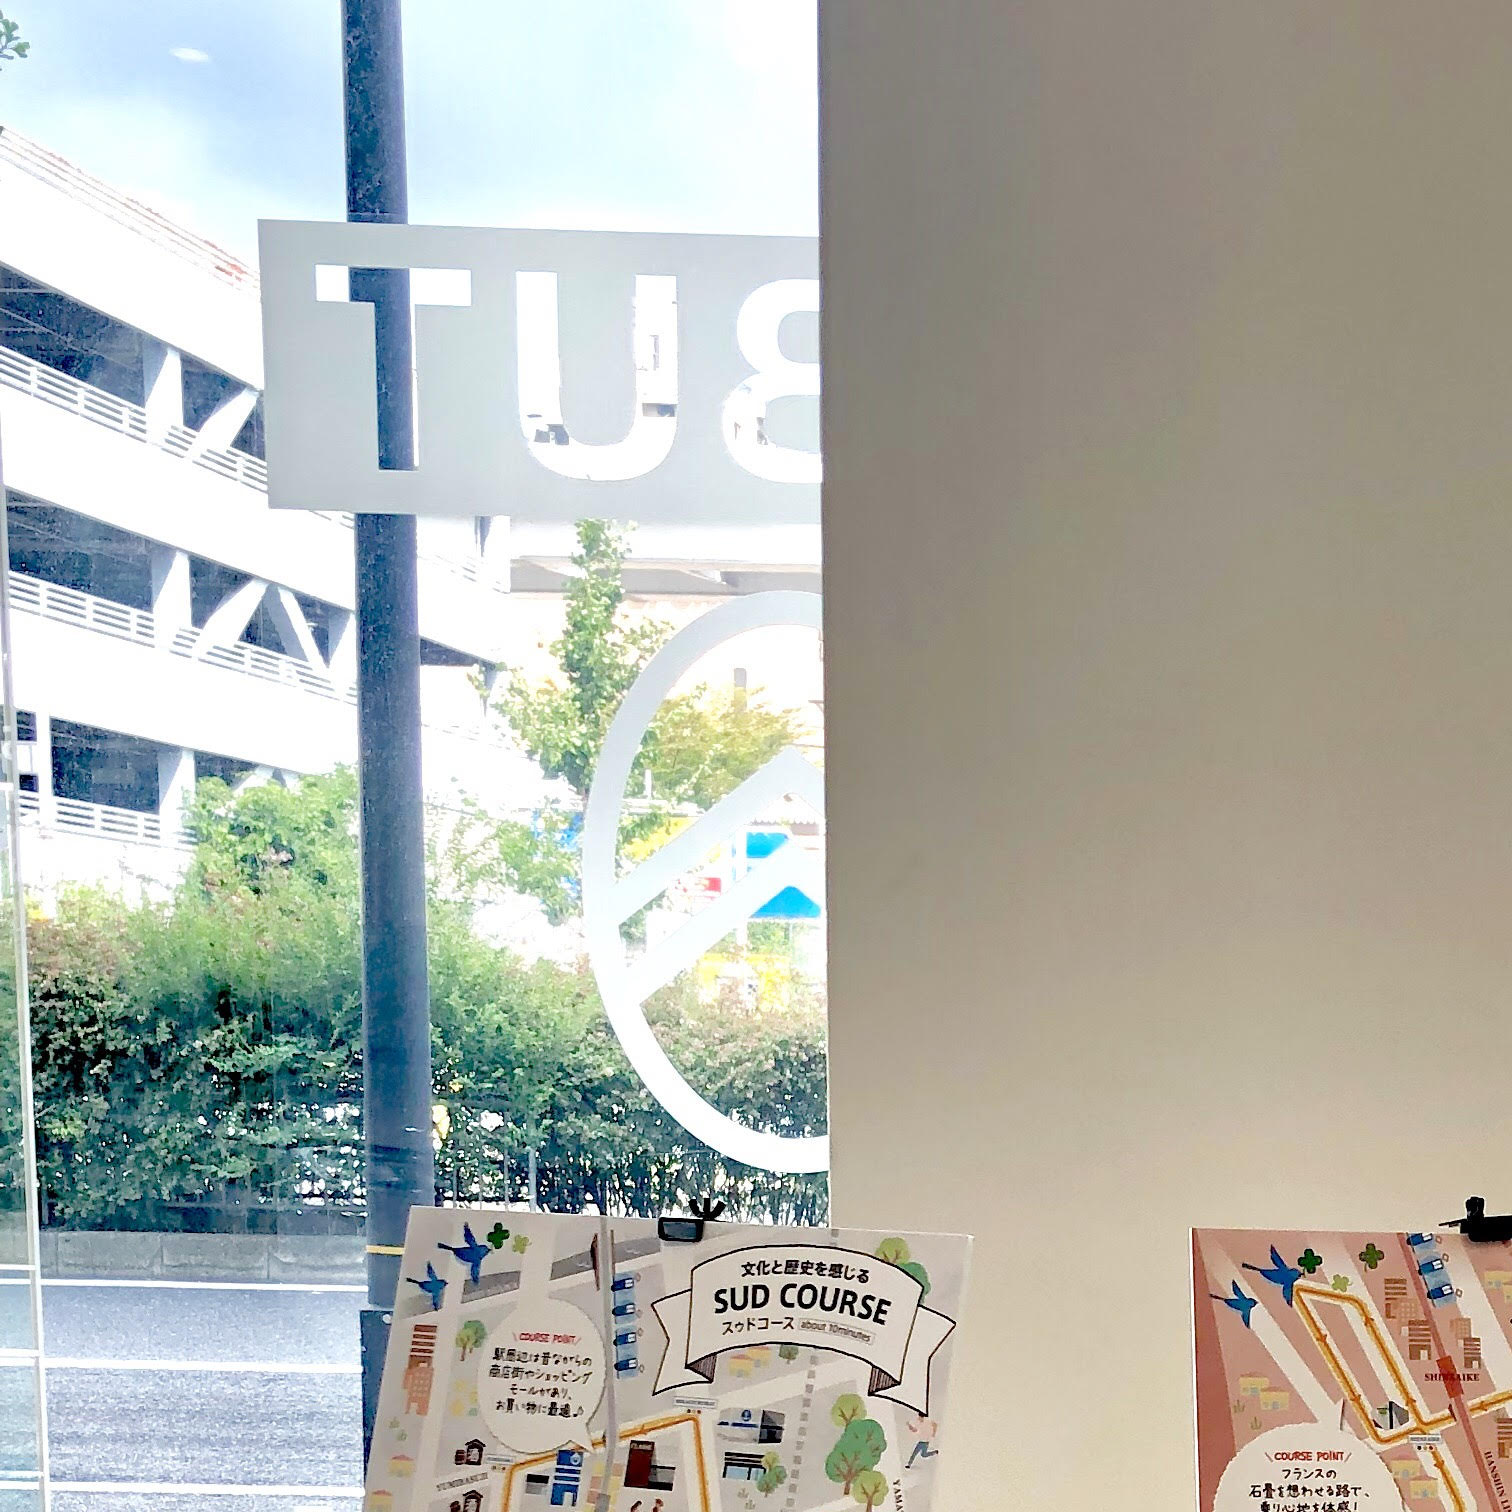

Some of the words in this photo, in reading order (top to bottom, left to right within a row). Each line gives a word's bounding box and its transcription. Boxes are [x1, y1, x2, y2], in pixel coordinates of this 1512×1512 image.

[741, 1259, 869, 1284] 文化と歴史を感じる
[714, 1284, 770, 1314] SUD
[779, 1283, 892, 1325] COURSE
[722, 1317, 795, 1335] スゥドコース
[800, 1319, 826, 1330] about
[519, 1332, 549, 1343] COURSE
[552, 1334, 577, 1344] POINT
[1274, 1450, 1314, 1462] COURSE
[1316, 1450, 1345, 1462] POINT
[1281, 1466, 1338, 1480] フランスの
[1483, 1451, 1507, 1497] HANSHIN
